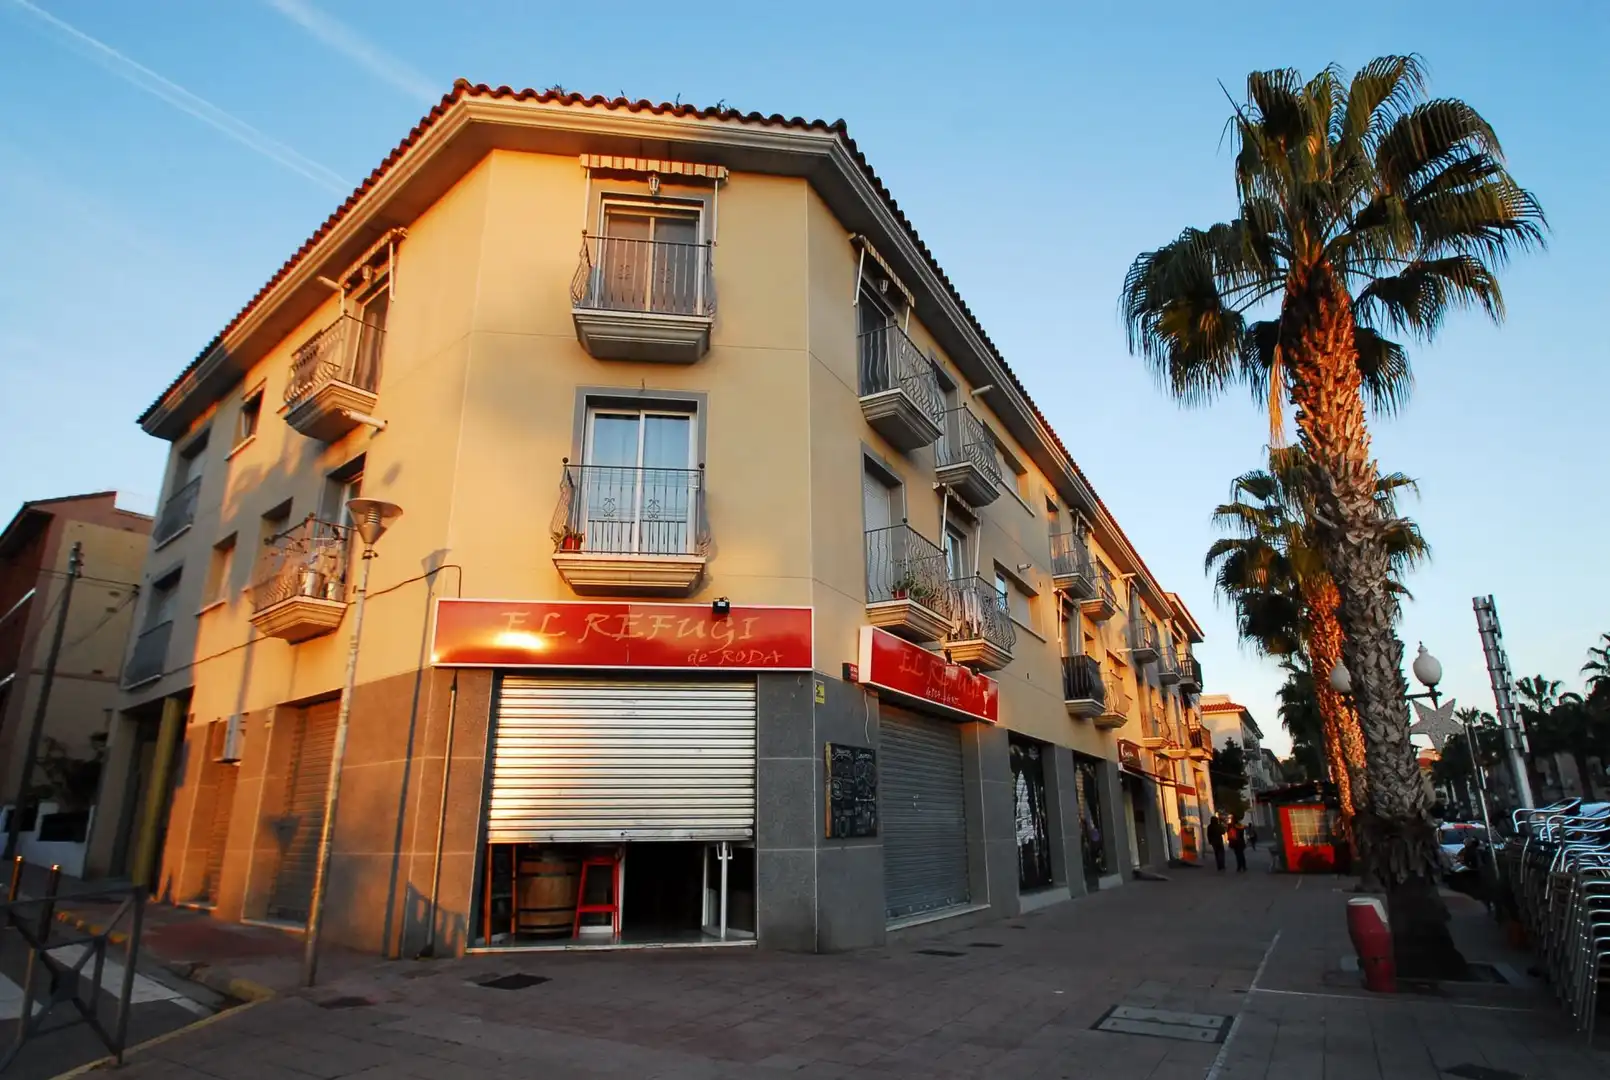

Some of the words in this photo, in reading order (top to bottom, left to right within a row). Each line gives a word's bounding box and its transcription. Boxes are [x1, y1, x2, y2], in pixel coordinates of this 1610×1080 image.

[500, 612, 566, 638] EL
[577, 612, 760, 653] REFUGI
[687, 649, 708, 666] de
[719, 649, 783, 664] RODA
[898, 647, 924, 677] EL
